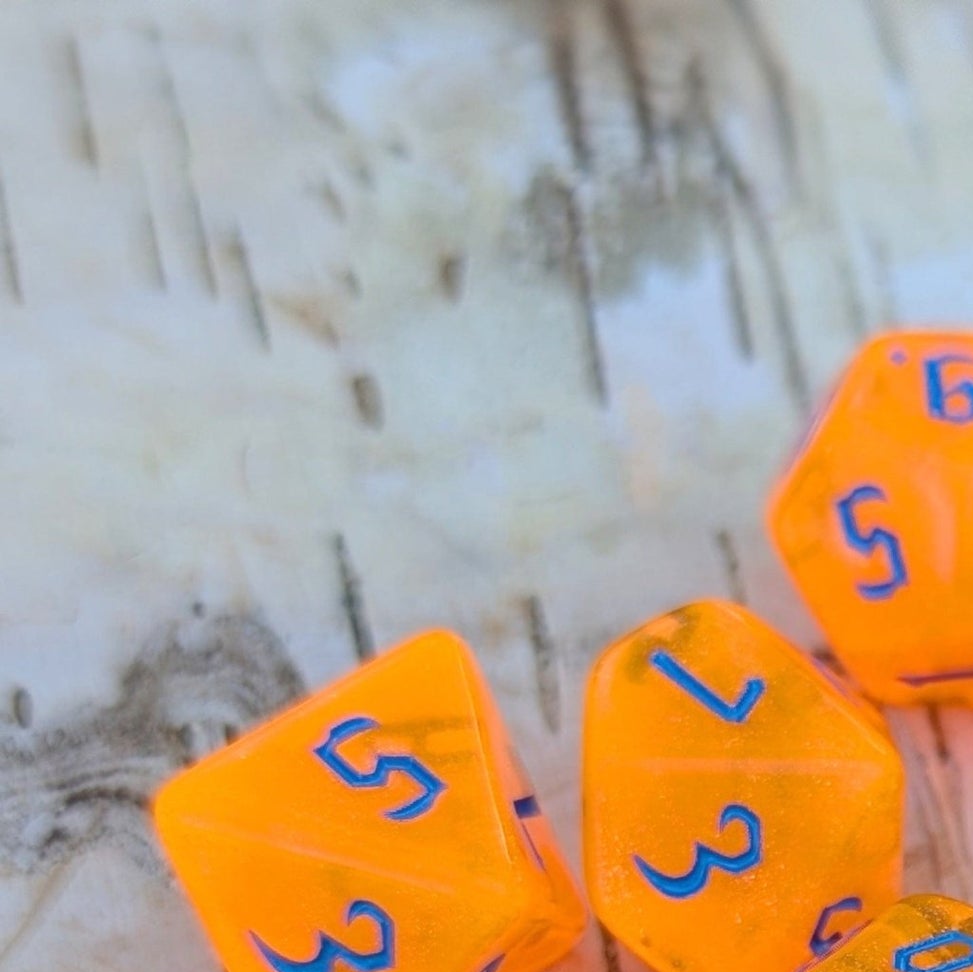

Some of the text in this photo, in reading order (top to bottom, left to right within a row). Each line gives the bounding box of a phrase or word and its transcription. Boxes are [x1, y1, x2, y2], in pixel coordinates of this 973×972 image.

[835, 484, 909, 601] 5
[312, 716, 447, 822] 5
[633, 803, 763, 900] 3
